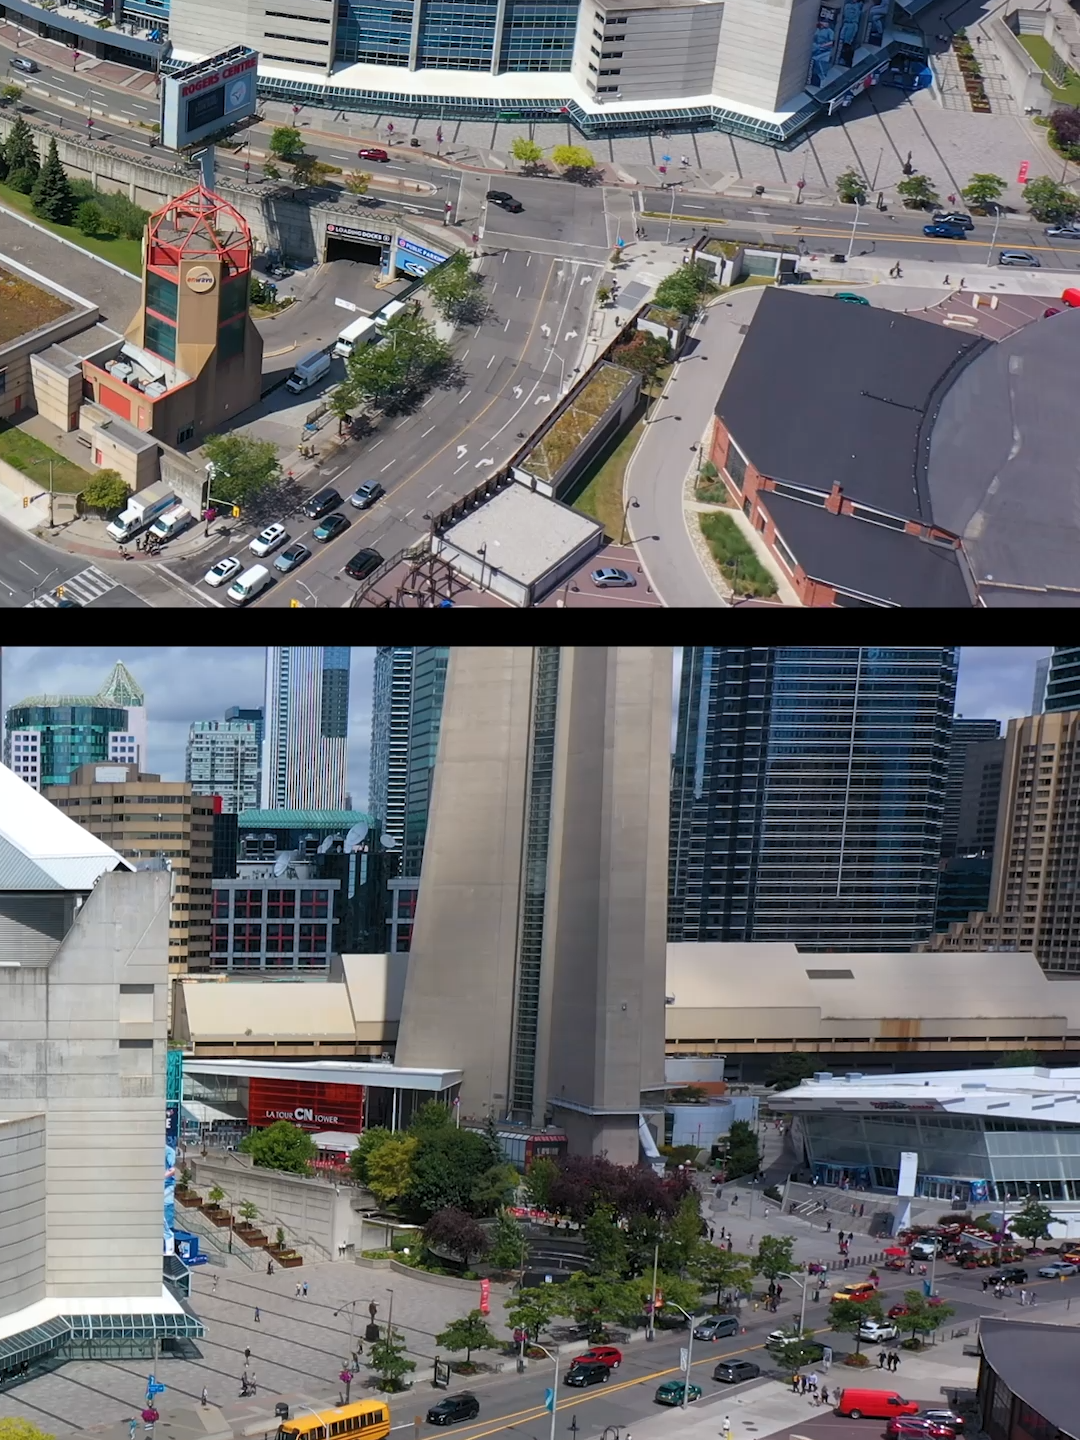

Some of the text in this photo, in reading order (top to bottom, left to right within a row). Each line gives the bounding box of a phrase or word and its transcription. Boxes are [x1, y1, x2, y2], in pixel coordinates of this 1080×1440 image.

[181, 57, 257, 97] ROGERS CENTRE
[335, 226, 382, 241] LOADING DOCKS
[406, 243, 446, 263] PUBLIC PARKIN
[276, 1111, 293, 1119] TOUR
[294, 1108, 313, 1121] CN
[315, 1115, 338, 1123] TOWER
